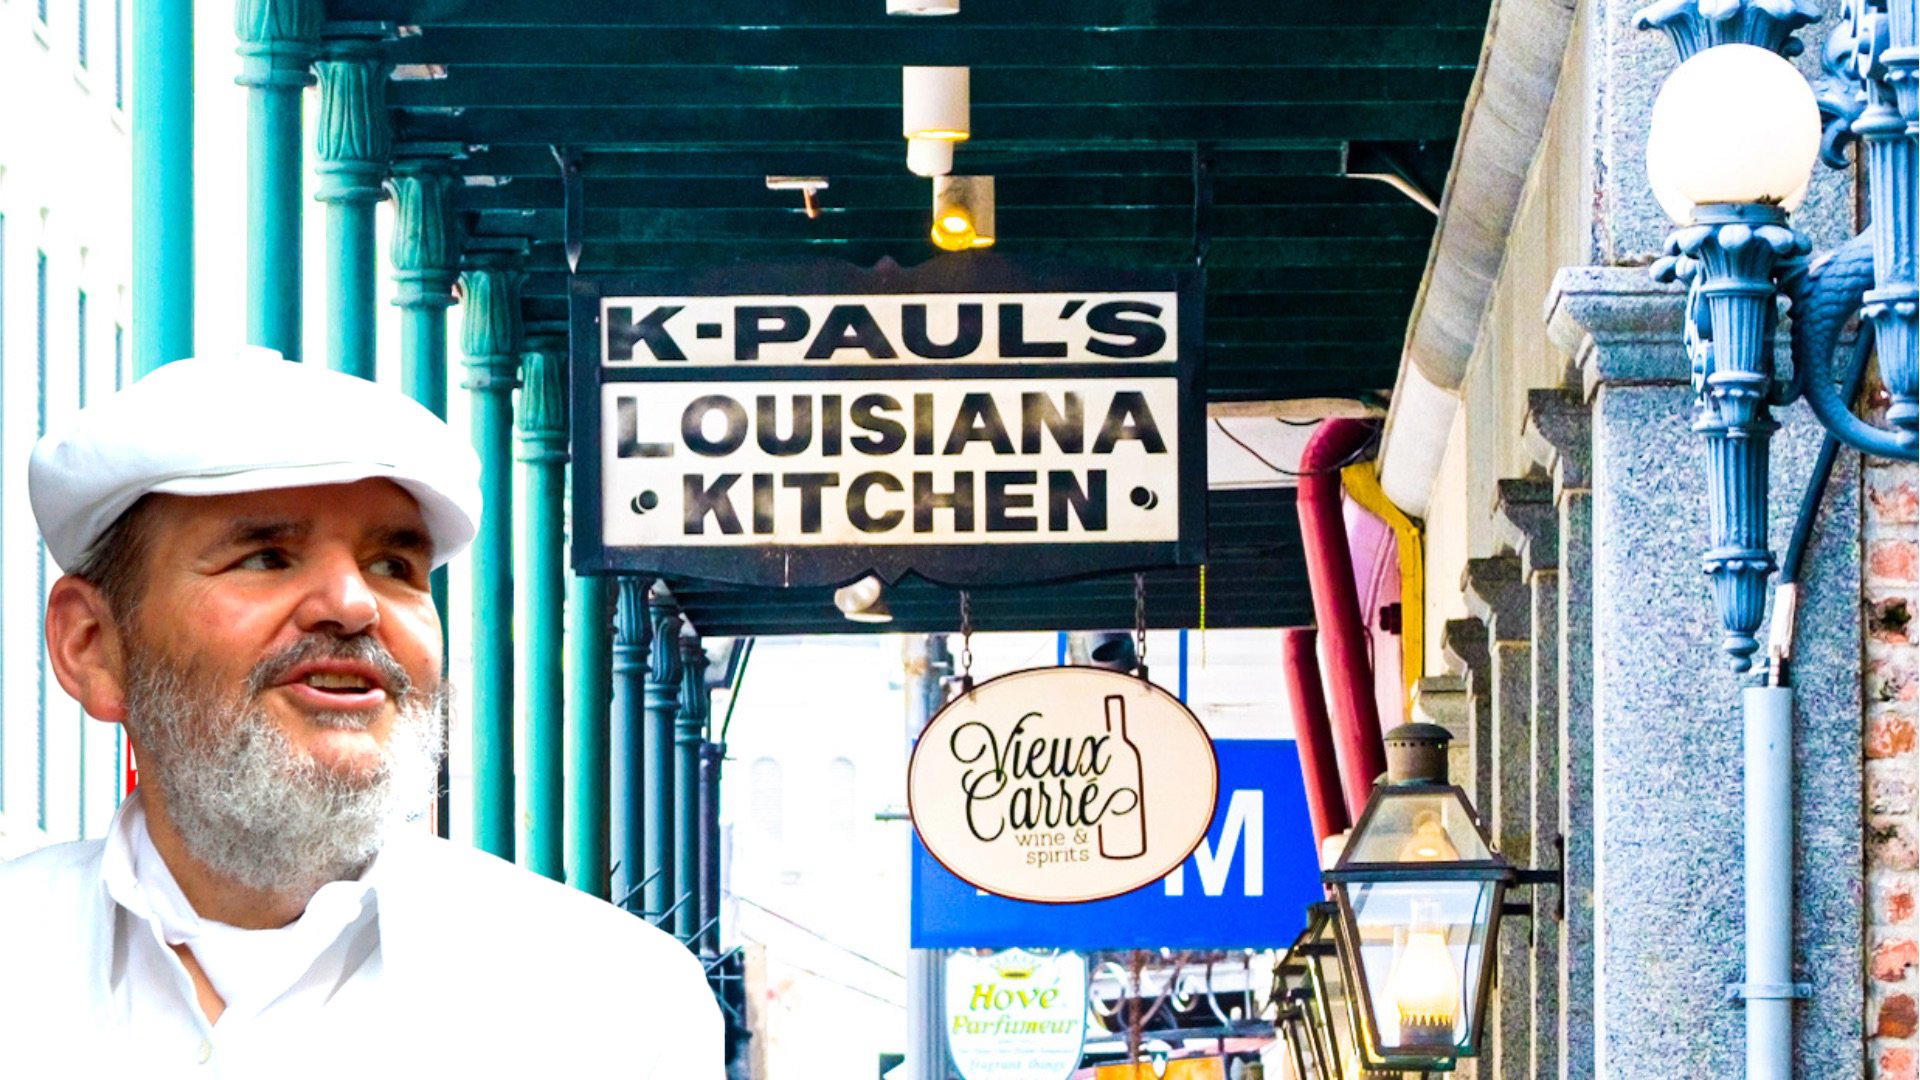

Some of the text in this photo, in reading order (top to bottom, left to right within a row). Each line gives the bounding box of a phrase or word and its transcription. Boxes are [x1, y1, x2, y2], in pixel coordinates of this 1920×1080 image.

[607, 301, 1167, 361] K-PAUL'S
[616, 391, 1168, 459] LOUISIANA
[683, 468, 1108, 535] KITCHEN
[950, 712, 1112, 783] Vieux
[961, 768, 1138, 842] Carré
[1015, 828, 1089, 847] wine &
[1026, 847, 1090, 868] spirits
[969, 977, 1060, 1011] Hové
[952, 1014, 1078, 1036] Parfumeur
